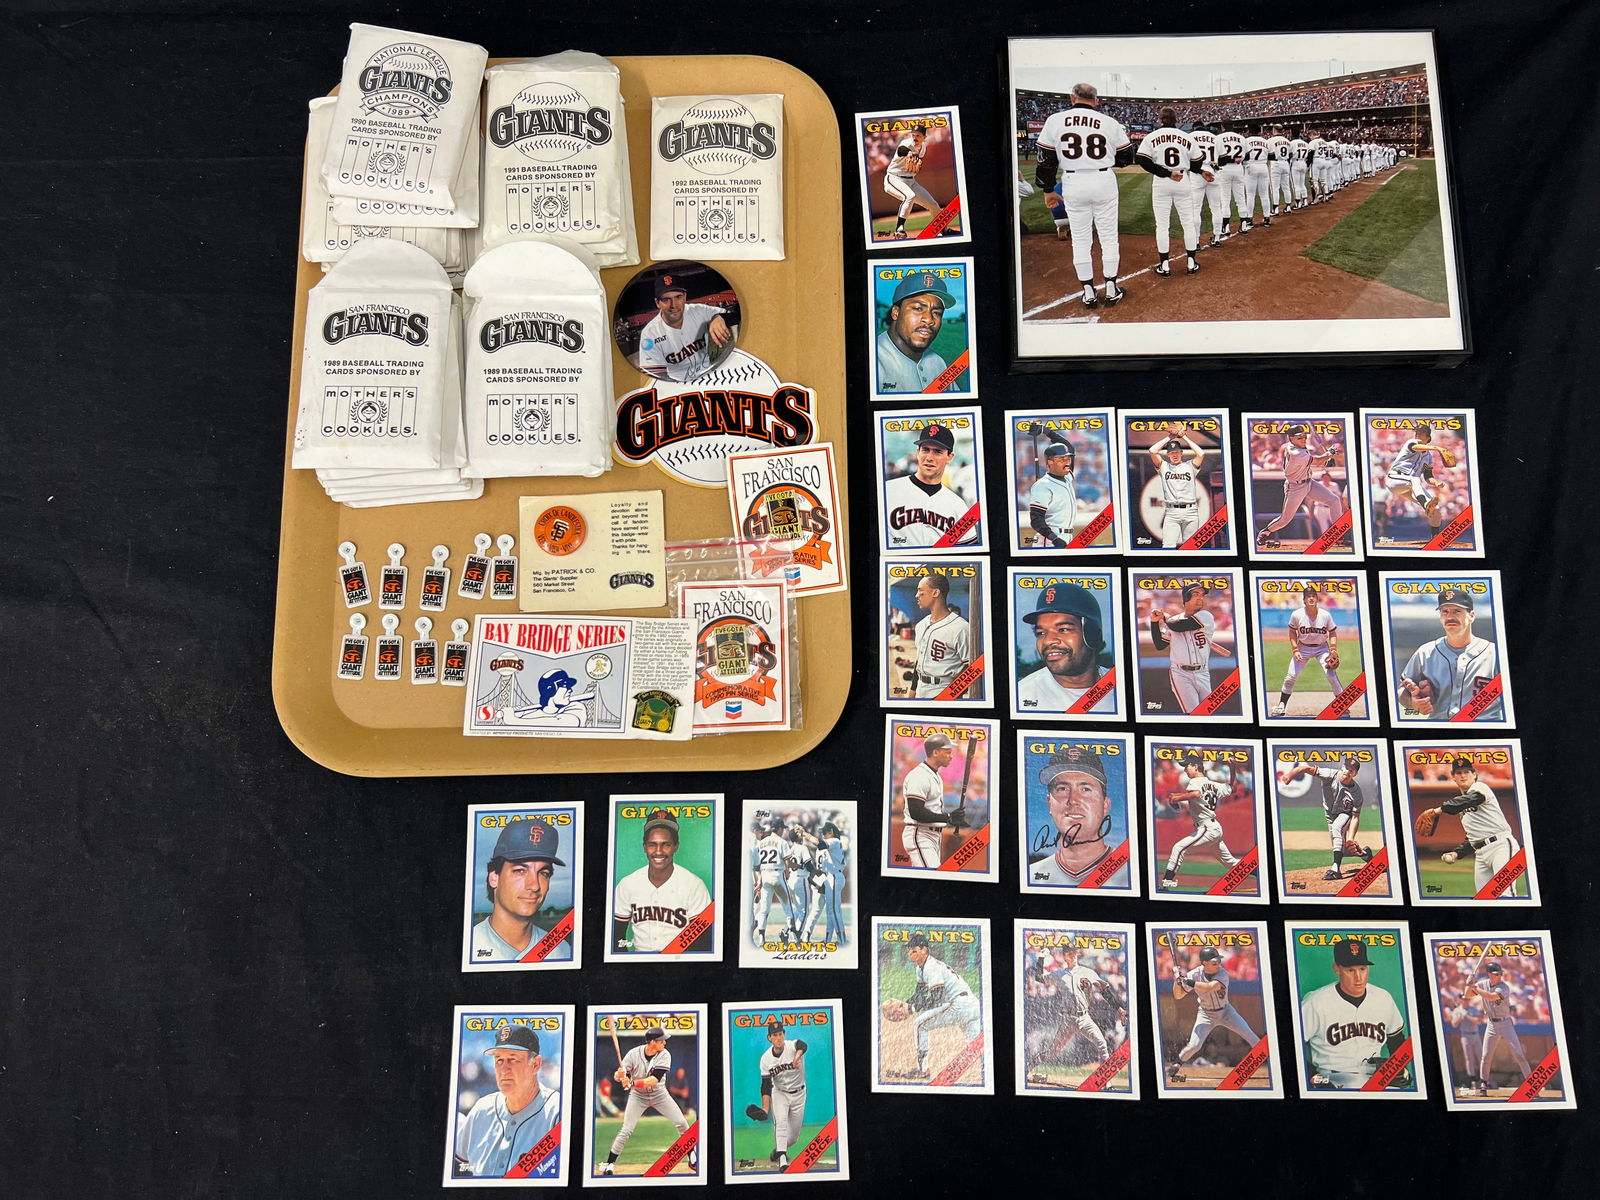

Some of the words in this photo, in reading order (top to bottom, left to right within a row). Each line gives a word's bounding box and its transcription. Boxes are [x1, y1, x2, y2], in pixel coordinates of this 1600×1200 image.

[374, 46, 419, 65] NATIONAL
[420, 49, 447, 76] LEAGUE
[359, 66, 453, 104] GIANTS
[367, 91, 435, 114] CHAMPIONS
[387, 108, 410, 116] 1989
[352, 126, 377, 134] CARDS
[379, 128, 425, 140] SPONSORED
[369, 120, 406, 129] BASEBALL
[409, 124, 442, 134] TRADING
[489, 105, 612, 148] GIANTS
[1065, 116, 1101, 129] CRAIG
[658, 120, 776, 162] GIANTS
[1061, 133, 1107, 160] 38
[1151, 134, 1192, 150] THOMPSON
[1223, 145, 1242, 158] 22
[1280, 147, 1286, 157] 9
[1164, 147, 1180, 167] 6
[341, 172, 425, 188] COOKIES
[510, 220, 592, 230] COOKIES
[349, 305, 364, 314] SAN
[366, 304, 410, 315] FRANCISCO
[504, 312, 519, 321] SAN
[521, 312, 564, 322] FRANCISCO
[322, 309, 429, 346] GIANTS
[480, 318, 584, 353] GIANTS
[654, 334, 667, 345] AT&T
[938, 364, 966, 391] MITCHELL
[939, 365, 958, 382] KEVIN
[616, 387, 812, 461] GIANTS
[768, 457, 793, 469] SAN
[743, 465, 820, 499] FRANCISCO
[947, 517, 969, 537] WILL
[949, 516, 976, 544] CLARK
[1078, 512, 1107, 542] JEFFREY
[1081, 516, 1113, 548] LEONARD
[1193, 516, 1219, 542] KELLY
[1194, 519, 1227, 548] DOWNS
[1319, 523, 1350, 552] MALDONADO
[1438, 519, 1472, 548] HAMMAKER
[1441, 521, 1459, 538] ATLEE
[609, 573, 654, 589] GIANTS
[720, 591, 745, 600] SAN
[694, 601, 771, 624] FRANCISCO
[485, 623, 514, 643] BAY
[517, 624, 572, 654] BRIDGE
[576, 625, 626, 650] SERIES
[415, 667, 434, 675] GIANT
[490, 659, 524, 671] GIANTS
[719, 660, 746, 669] GIANT
[949, 666, 975, 691] EDDIE
[950, 667, 982, 698] MILNER
[705, 686, 761, 699] COMMEMORATIVE
[1082, 681, 1114, 711] HENDERSON
[1087, 685, 1101, 700] DAVE
[1206, 682, 1238, 713] ALDRETE
[1207, 684, 1228, 702] MIKE
[1331, 684, 1357, 708] CHRIS
[1333, 687, 1364, 716] SPEIER
[1468, 688, 1499, 719] BRENLY
[1470, 690, 1489, 707] BOB
[760, 850, 777, 864] 22
[953, 837, 981, 860] CHILI
[956, 840, 985, 867] DAVIS
[1094, 854, 1128, 885] REUSCHEL
[1098, 857, 1115, 872] RICK
[1225, 861, 1248, 883] MIKE
[1354, 863, 1375, 884] SCOTT
[1494, 868, 1510, 883] DON
[1222, 860, 1258, 894] KRUKOW
[1353, 863, 1386, 894] GARRELTS
[1491, 864, 1523, 896] ROBINSON
[541, 927, 560, 945] DAVE
[679, 919, 703, 941] JOSE
[680, 920, 710, 949] URIBE
[536, 924, 573, 960] DRAVECKY
[763, 942, 837, 952] GIANTS
[1438, 944, 1537, 957] GIANTS
[772, 950, 828, 960] Leaders
[735, 1012, 828, 1027] GIANTS
[1326, 1023, 1386, 1046] GIANTS
[1233, 1052, 1267, 1087] THOMPSON
[1236, 1053, 1255, 1075] ROBBY
[1378, 1053, 1410, 1088] WILLIAMS
[1379, 1055, 1399, 1075] MATT
[1526, 1063, 1558, 1098] MELVIN
[1527, 1066, 1545, 1086] BOB
[519, 1135, 554, 1168] ROGER
[524, 1141, 557, 1173] CRAIG
[660, 1136, 697, 1174] YOUNGBLOOD
[666, 1144, 682, 1158] JOEL
[803, 1135, 833, 1167] PRICE
[805, 1135, 824, 1156] JOE
